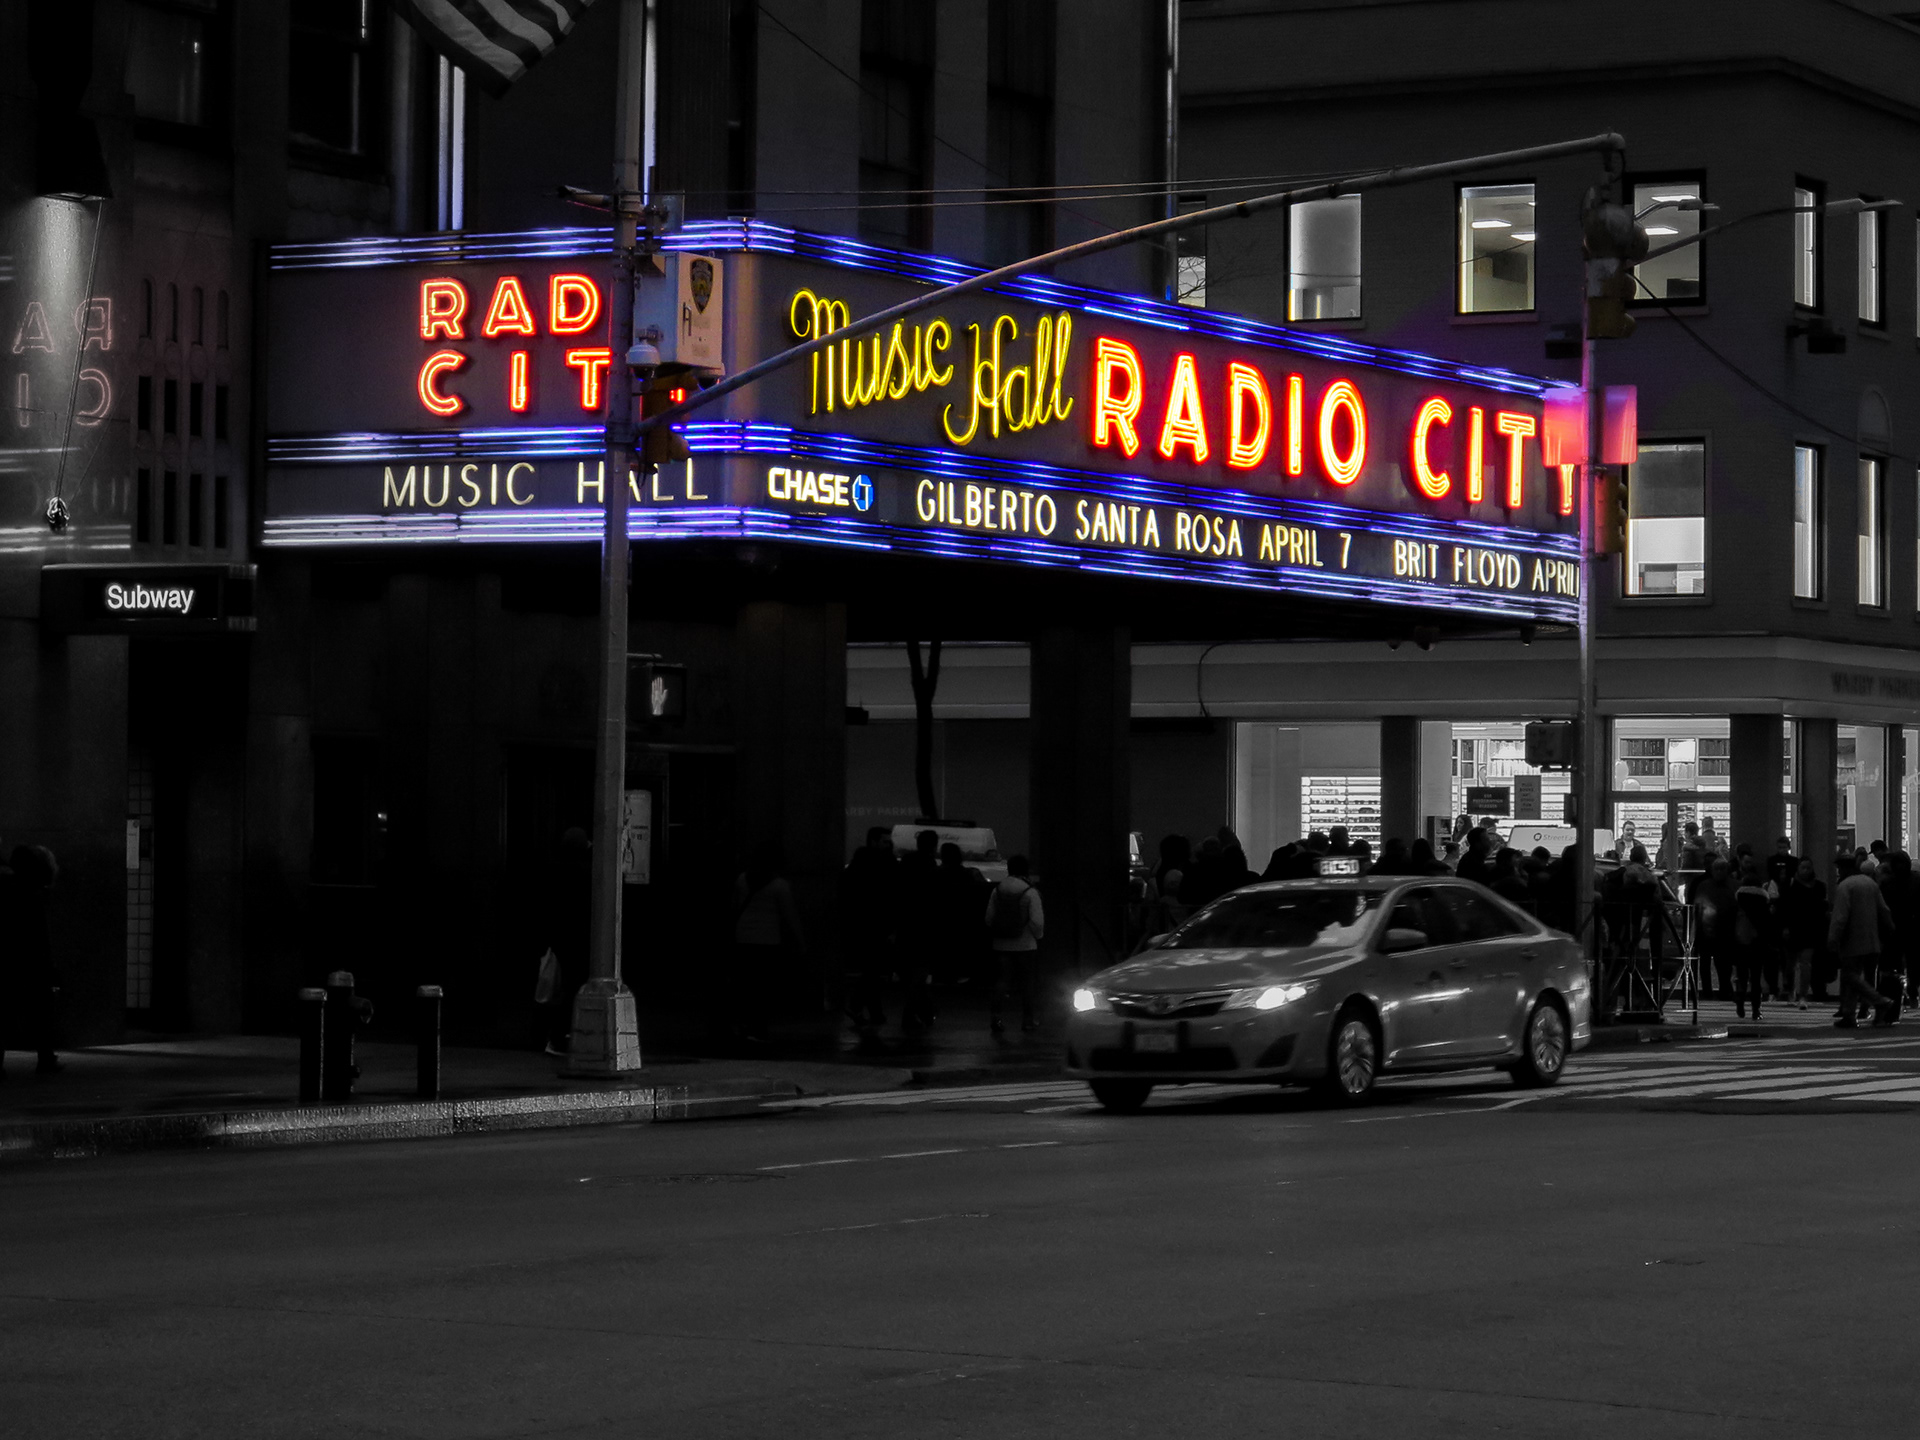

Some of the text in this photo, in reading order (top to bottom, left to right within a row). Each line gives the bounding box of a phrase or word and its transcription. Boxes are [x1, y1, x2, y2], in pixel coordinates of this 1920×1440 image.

[420, 273, 601, 340] RAD
[417, 347, 612, 416] CIT
[790, 287, 1074, 445] Music Hall
[1091, 337, 1368, 487] RADIO
[382, 462, 536, 508] MUSIC
[767, 466, 850, 507] CHASE
[916, 478, 1352, 570] GILBERTO SANTA ROSA APRIL 7
[1393, 539, 1440, 580] BRIT
[1453, 546, 1522, 590] FLOYD
[106, 583, 195, 614] Subway
